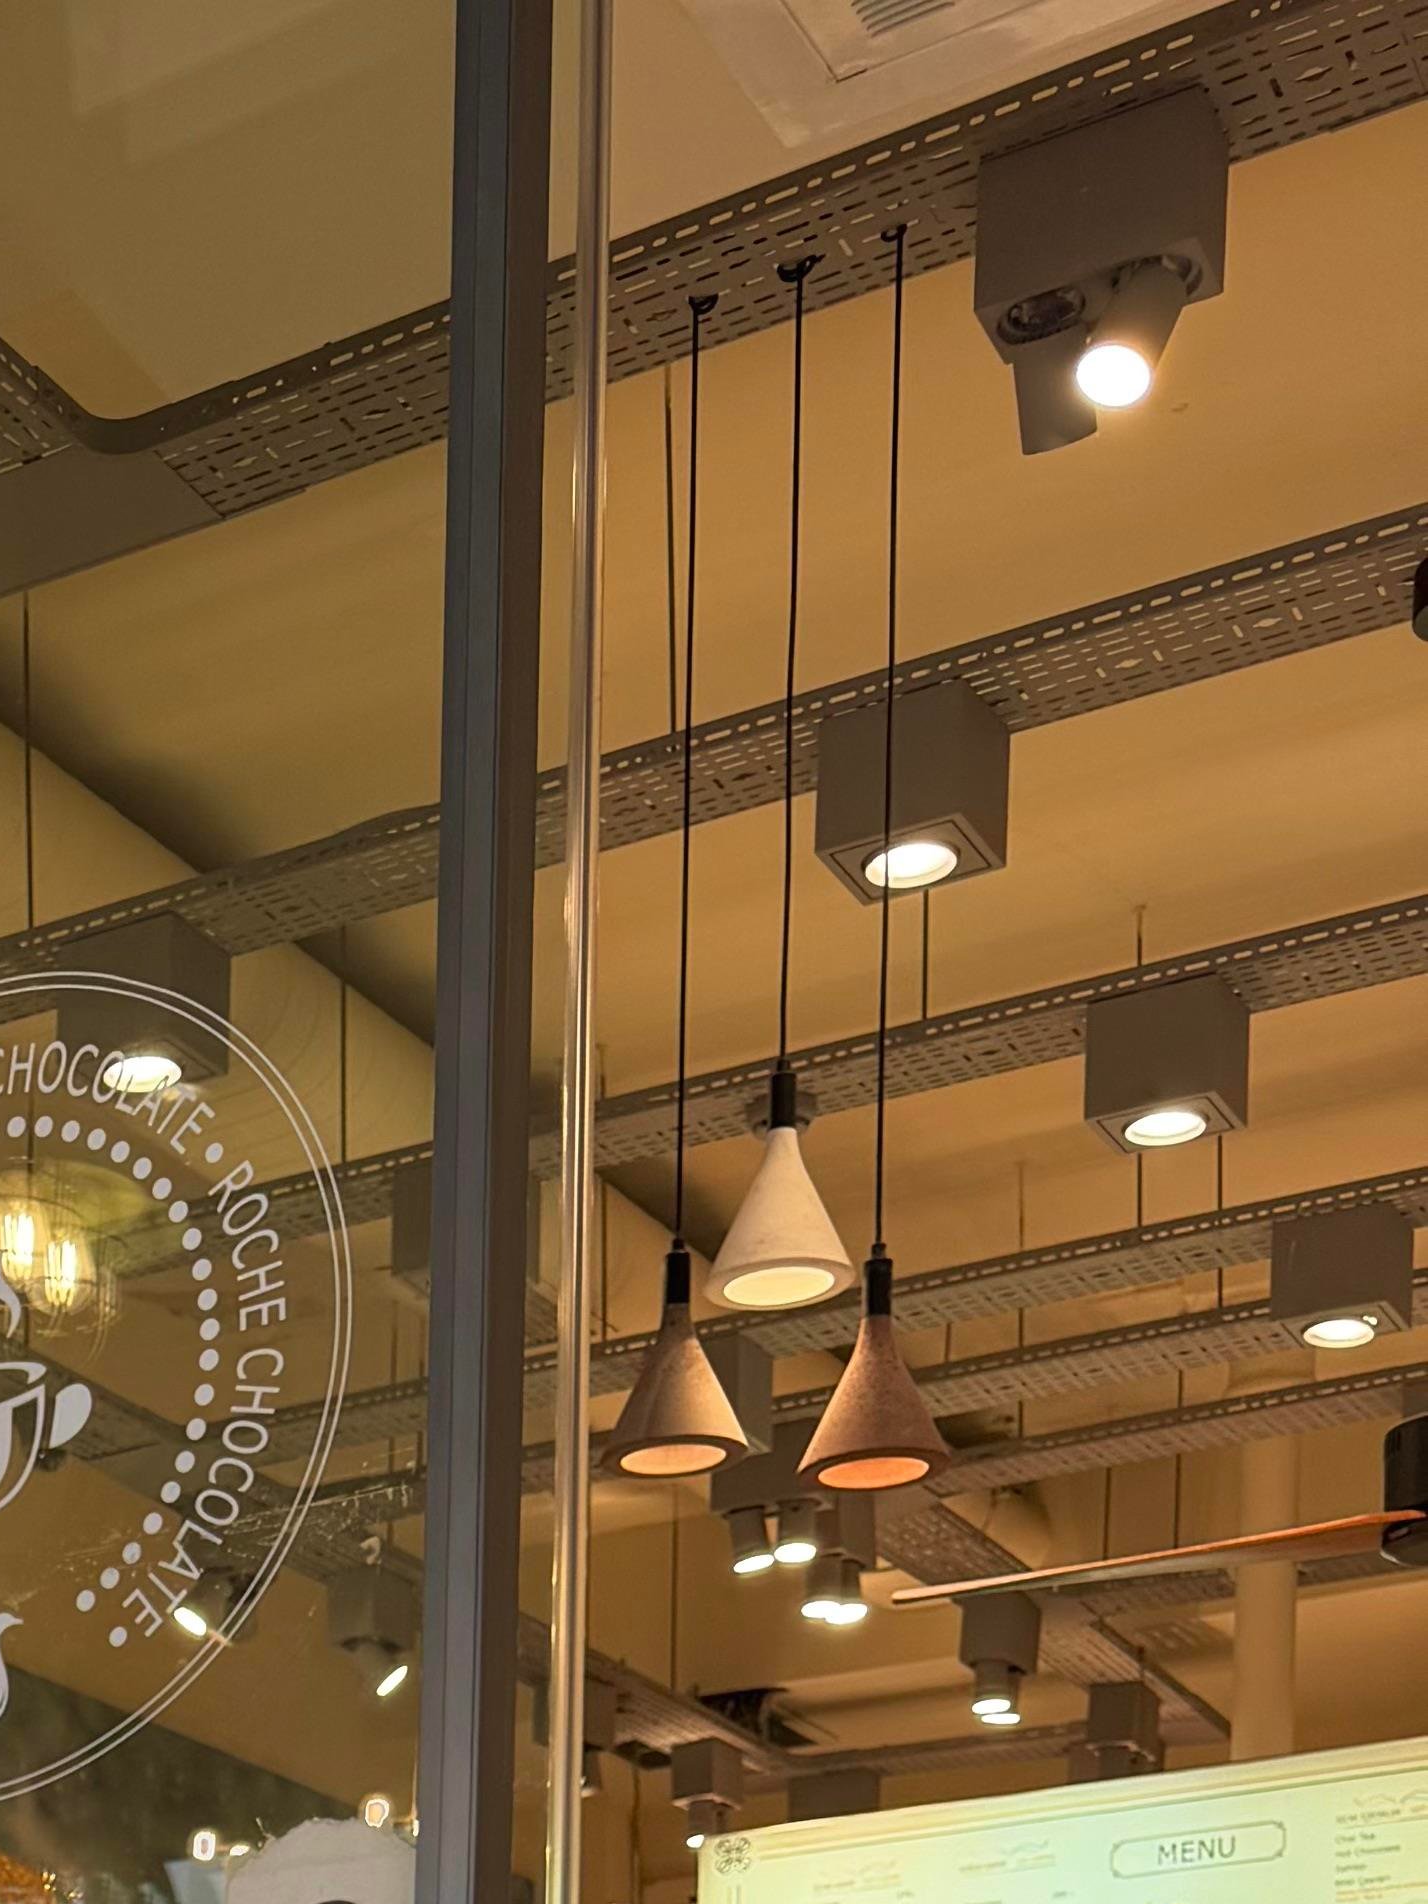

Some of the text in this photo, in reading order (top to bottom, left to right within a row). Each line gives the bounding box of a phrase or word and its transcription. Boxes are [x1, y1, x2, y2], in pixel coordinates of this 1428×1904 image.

[122, 1159, 286, 1638] ROCHE CHOCOLATE
[1156, 1835, 1237, 1867] MENU
